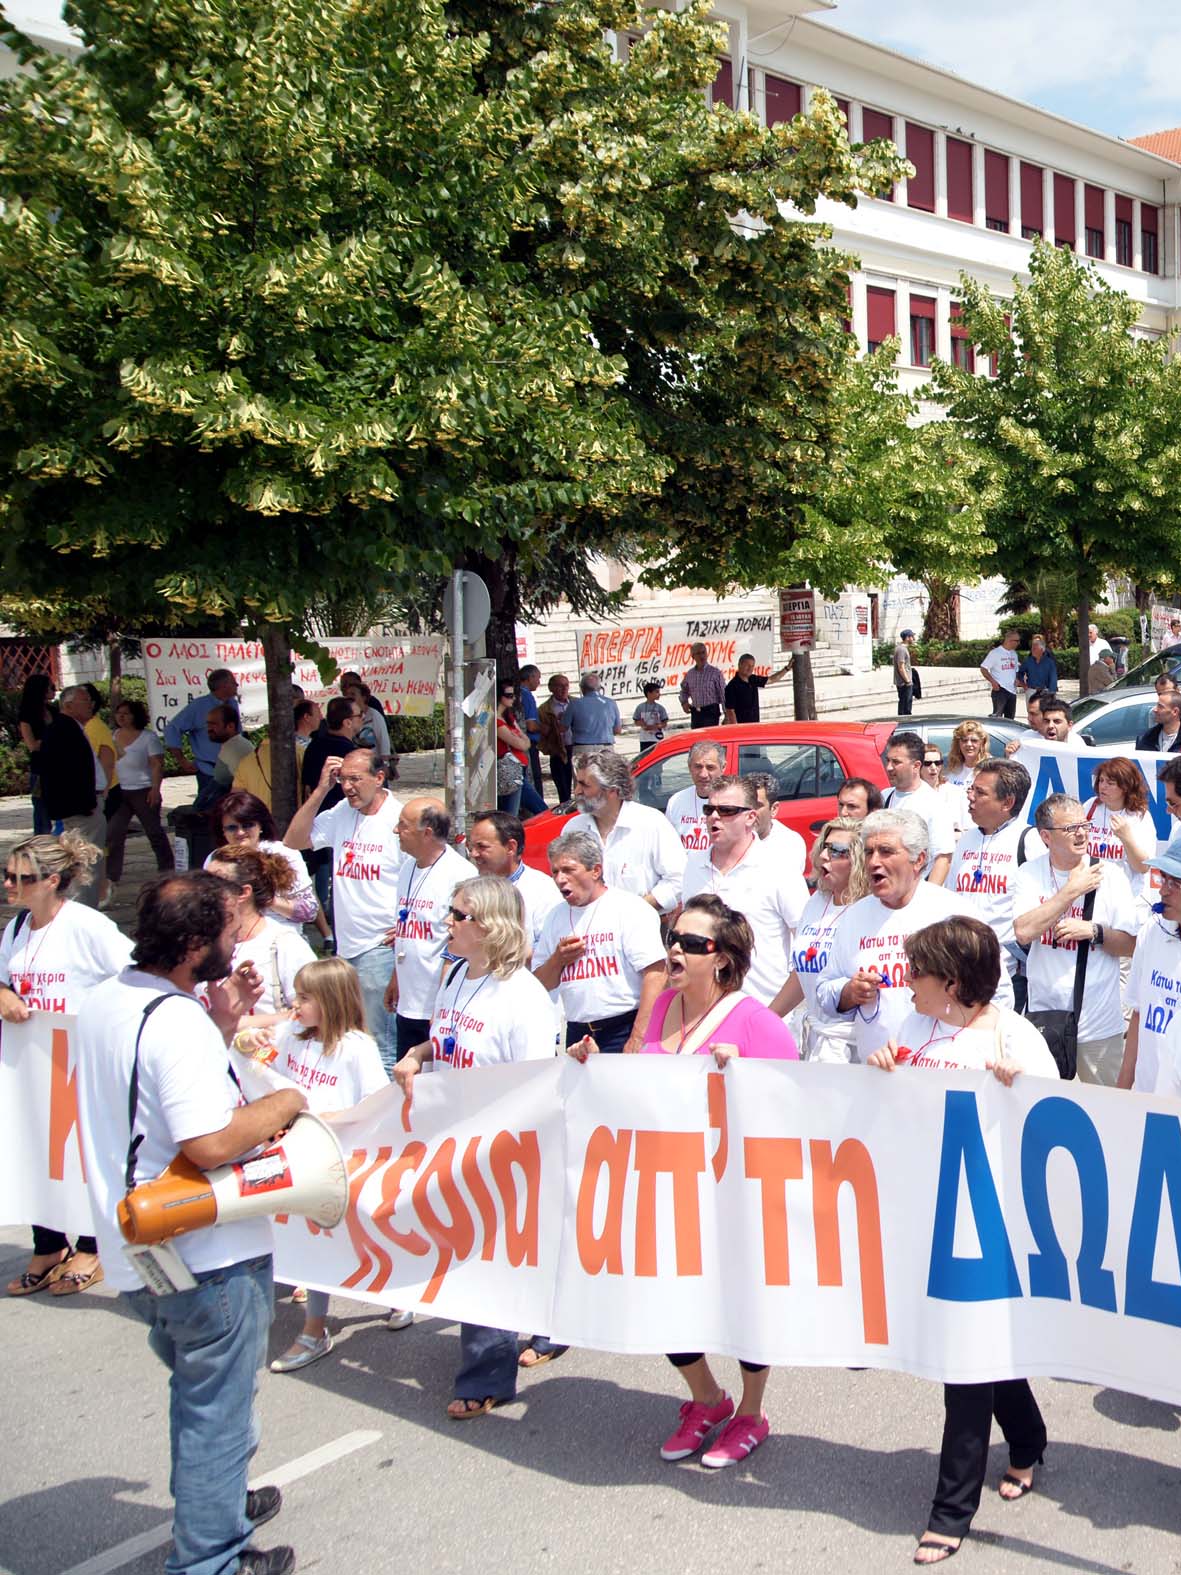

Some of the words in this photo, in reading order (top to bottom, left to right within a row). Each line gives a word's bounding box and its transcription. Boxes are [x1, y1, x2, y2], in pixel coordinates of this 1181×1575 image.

[580, 626, 663, 668] ΑΠΕΡΓΙΑ
[888, 936, 898, 945] τα
[1151, 969, 1173, 991] Κάτω
[743, 1137, 889, 1346] τη
